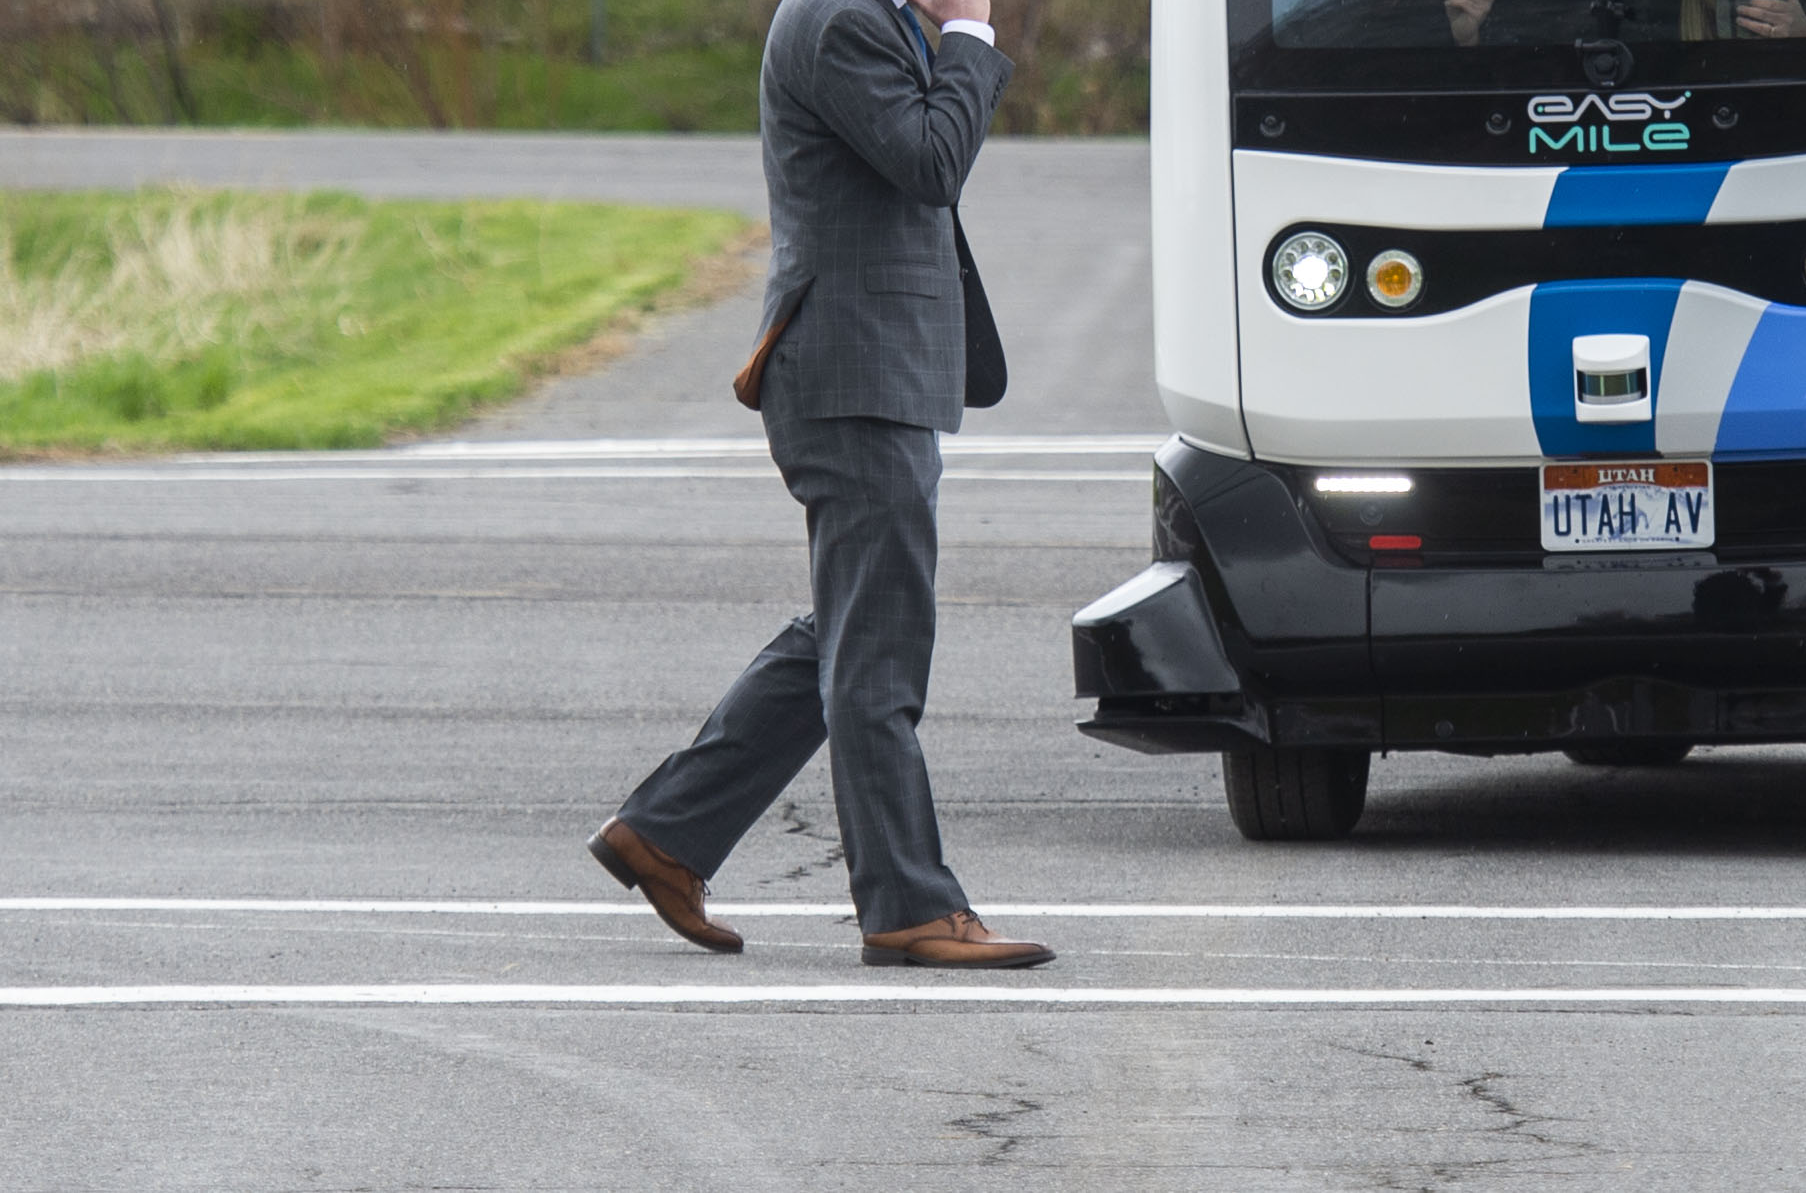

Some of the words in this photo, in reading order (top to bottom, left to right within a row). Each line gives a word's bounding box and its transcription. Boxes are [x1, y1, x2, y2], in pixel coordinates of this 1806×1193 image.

[1597, 468, 1655, 484] UTAH
[1553, 492, 1636, 537] UTAH
[1664, 491, 1703, 534] AV
